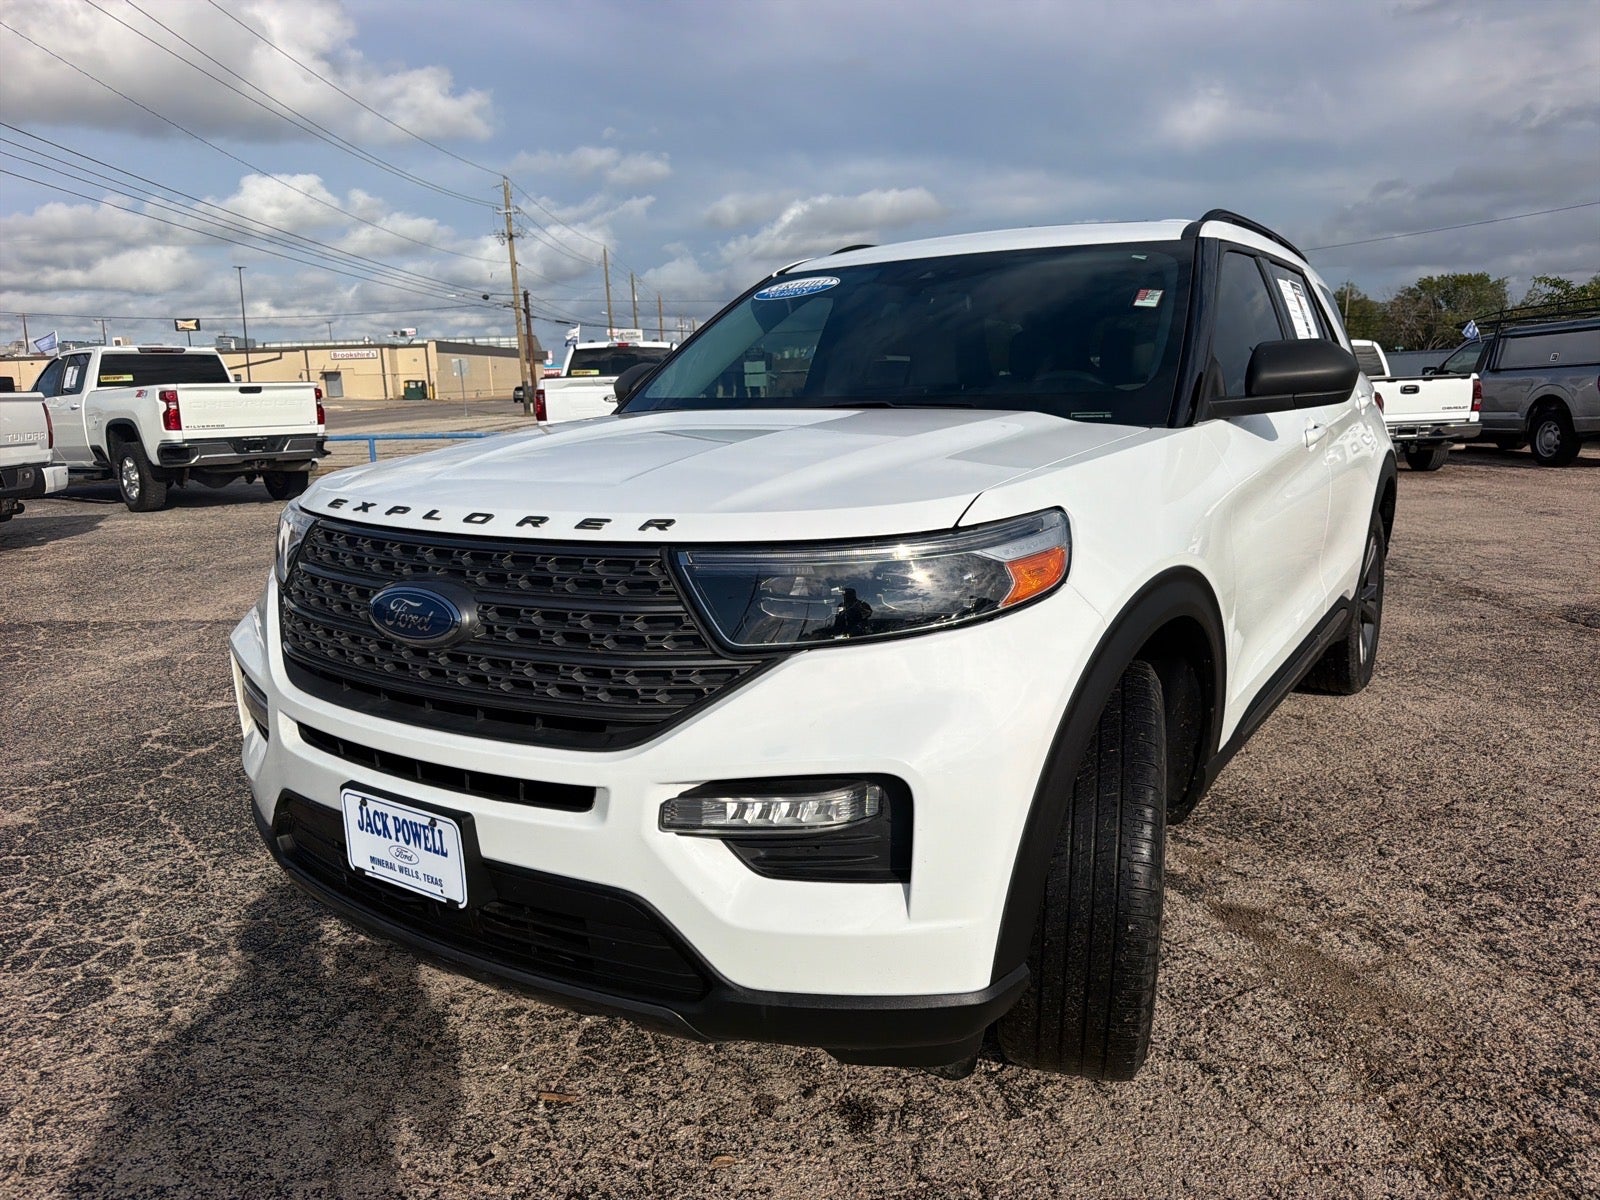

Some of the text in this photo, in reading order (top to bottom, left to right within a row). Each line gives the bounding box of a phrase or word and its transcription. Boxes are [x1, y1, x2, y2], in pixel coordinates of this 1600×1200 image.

[332, 350, 376, 359] Brookshire's
[4, 431, 47, 442] TUNDRA
[327, 498, 677, 532] EXPLORER
[385, 597, 435, 632] Ford
[357, 806, 448, 858] JACK POWELL
[394, 847, 414, 862] Ford
[369, 855, 444, 888] MINERAL WELLS, TEXAS
